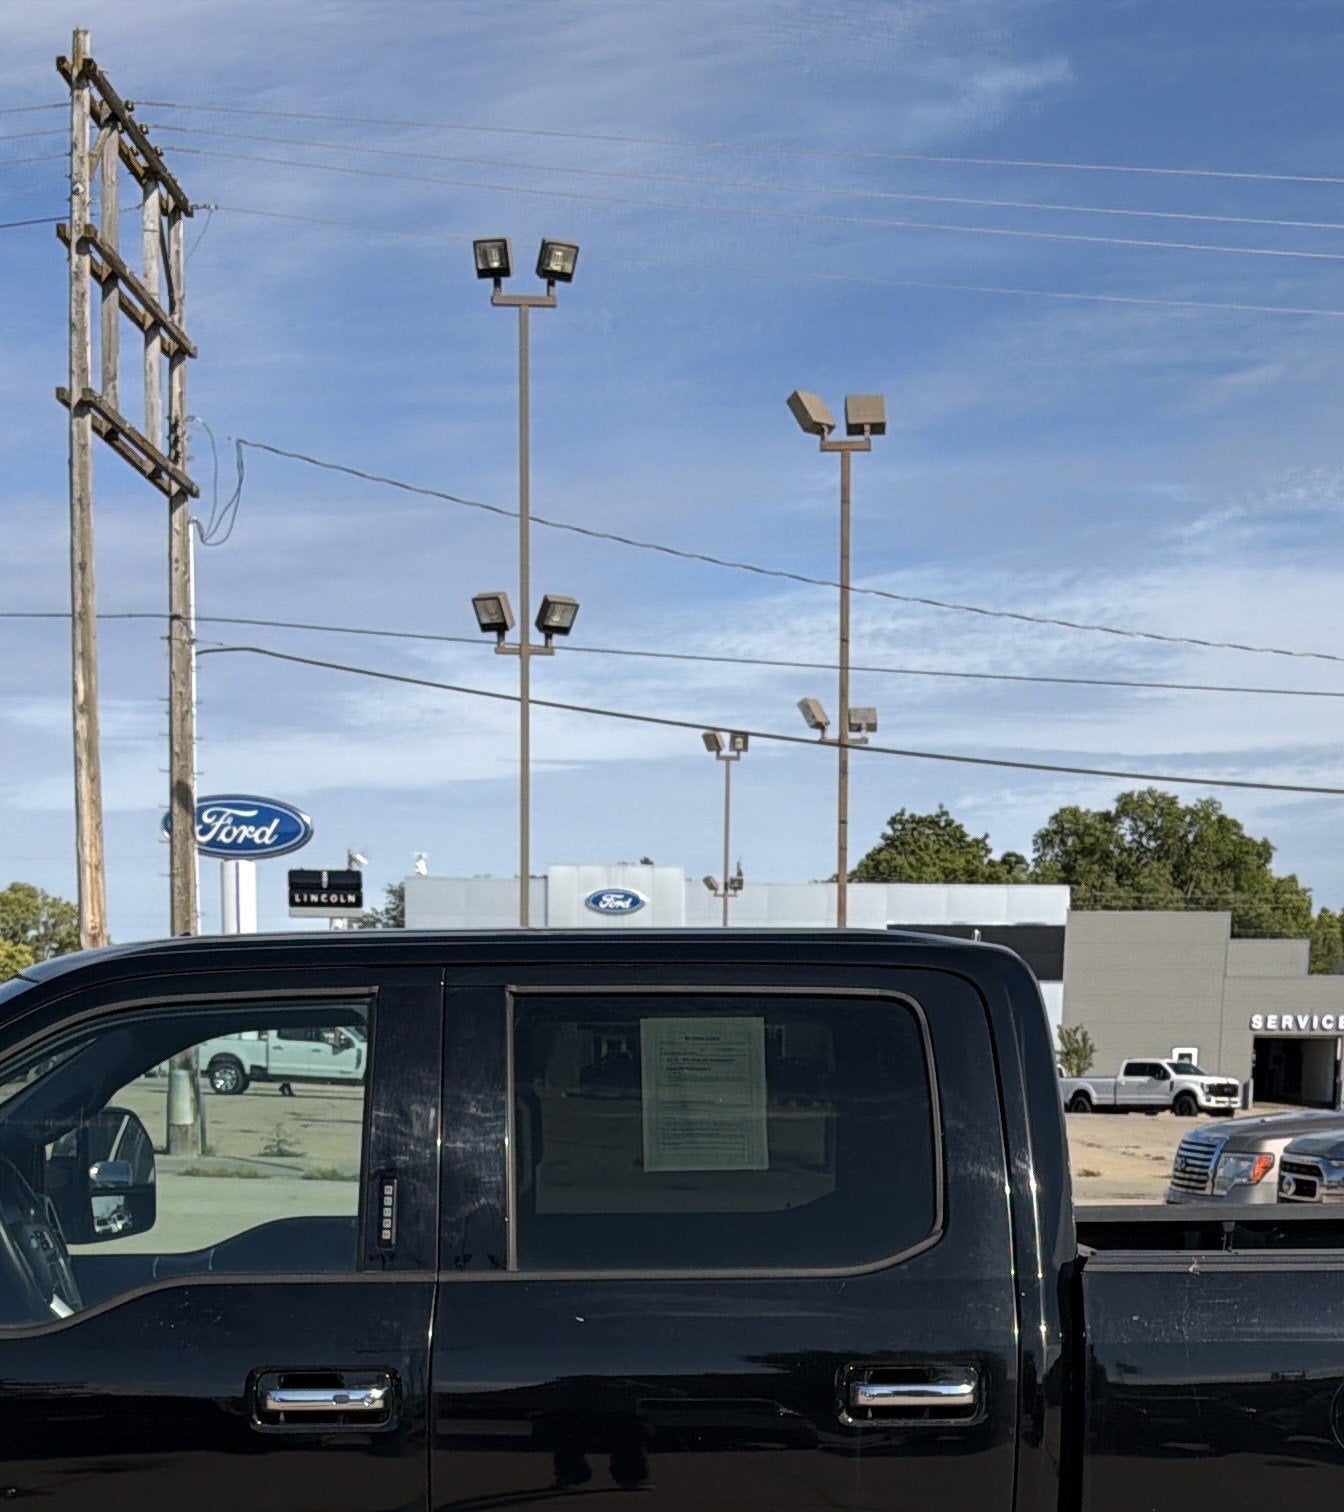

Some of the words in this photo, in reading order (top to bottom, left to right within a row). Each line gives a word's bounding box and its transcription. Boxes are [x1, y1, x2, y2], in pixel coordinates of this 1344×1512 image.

[194, 806, 280, 844] Ford
[294, 893, 356, 904] LINCOLN
[598, 894, 633, 908] Ford
